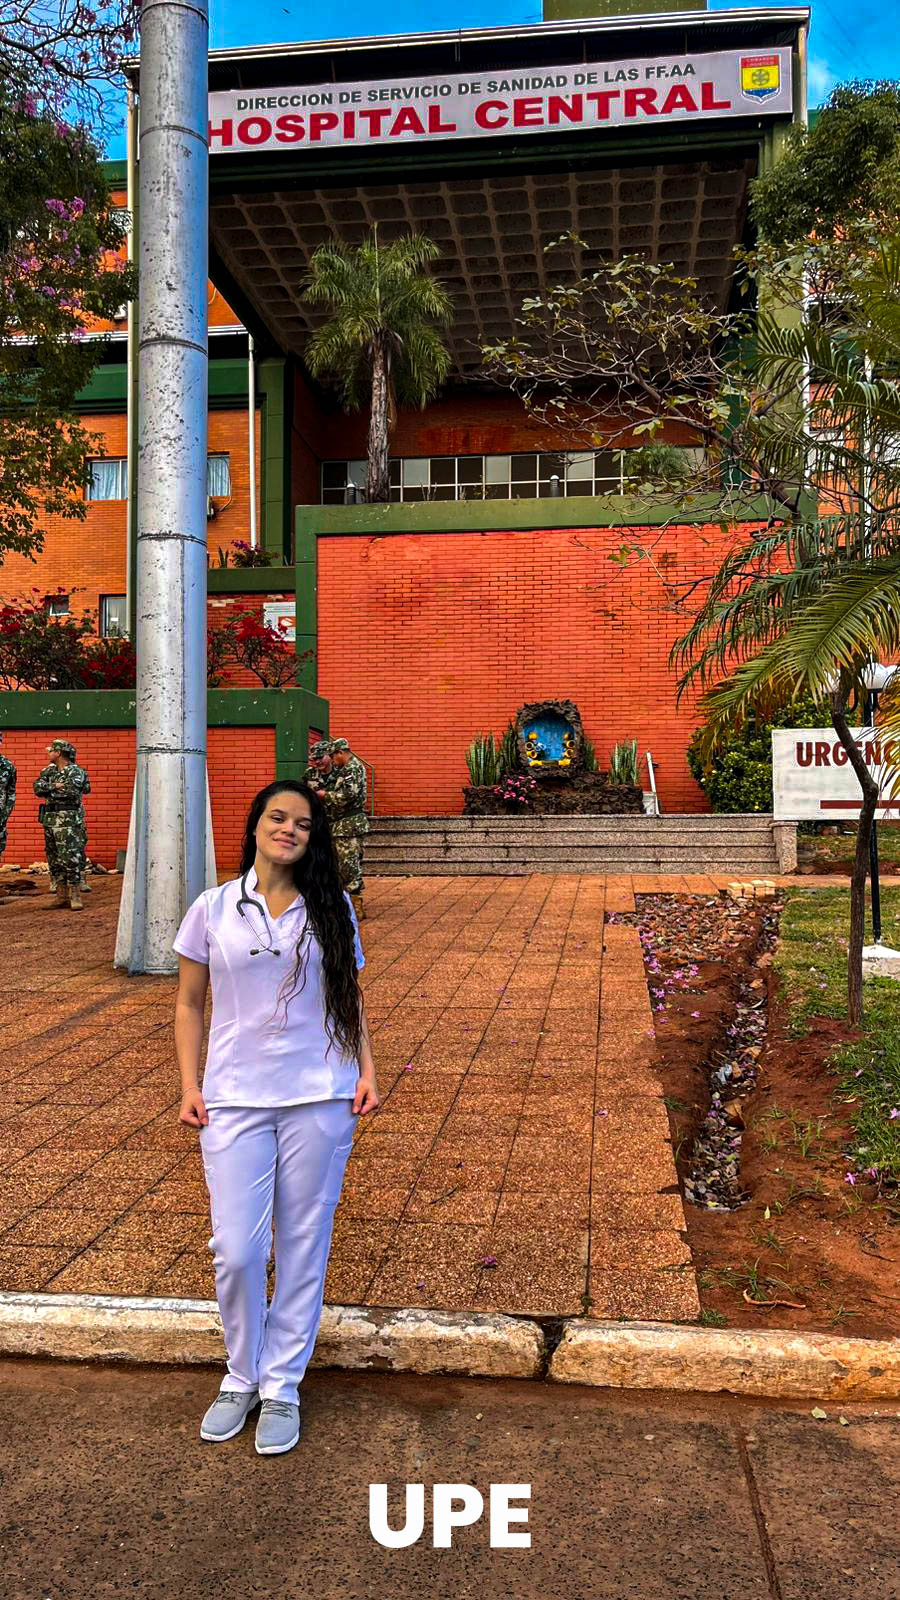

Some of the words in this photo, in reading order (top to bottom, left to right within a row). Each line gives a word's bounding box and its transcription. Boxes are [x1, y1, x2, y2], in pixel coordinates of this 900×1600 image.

[208, 104, 457, 147] HOSPITAL
[475, 81, 732, 130] CENTRAL
[236, 92, 333, 111] DIRECCION
[339, 90, 362, 105] DE
[367, 84, 451, 103] SERVICIO
[458, 81, 481, 96] DE
[487, 72, 568, 93] SANIDAD
[574, 71, 598, 87] DE
[604, 68, 639, 83] LAS
[645, 63, 696, 80] FF.AA
